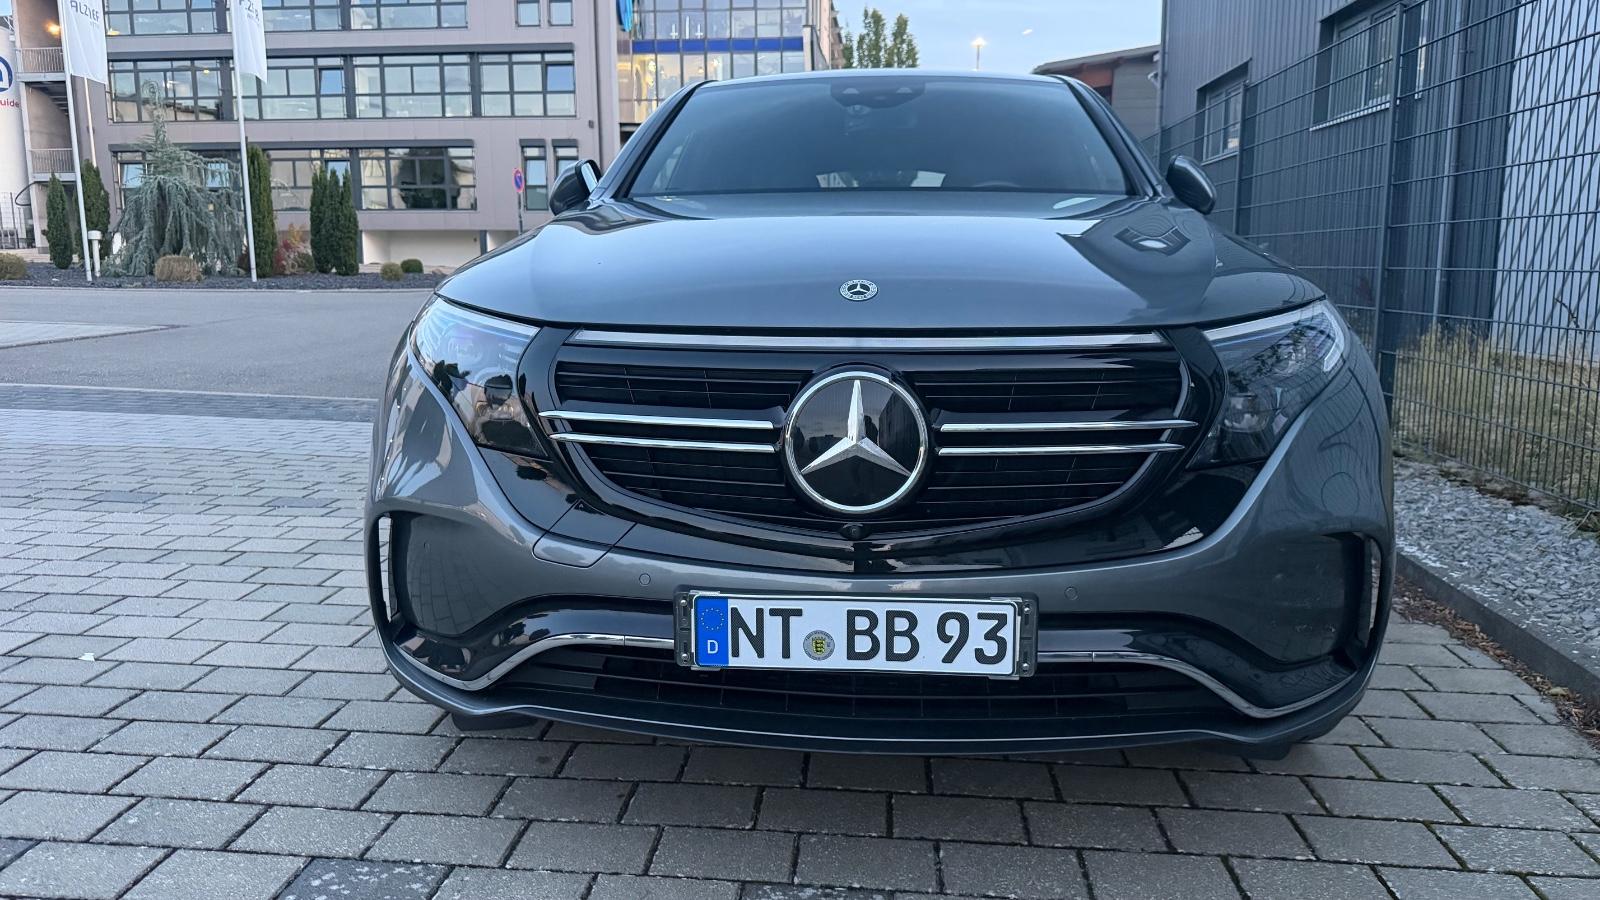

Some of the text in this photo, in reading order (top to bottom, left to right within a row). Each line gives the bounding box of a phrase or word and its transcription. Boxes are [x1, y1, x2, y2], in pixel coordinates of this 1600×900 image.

[707, 640, 719, 654] D
[730, 607, 803, 659] NT
[846, 609, 920, 662] BB
[936, 611, 1008, 665] 93
